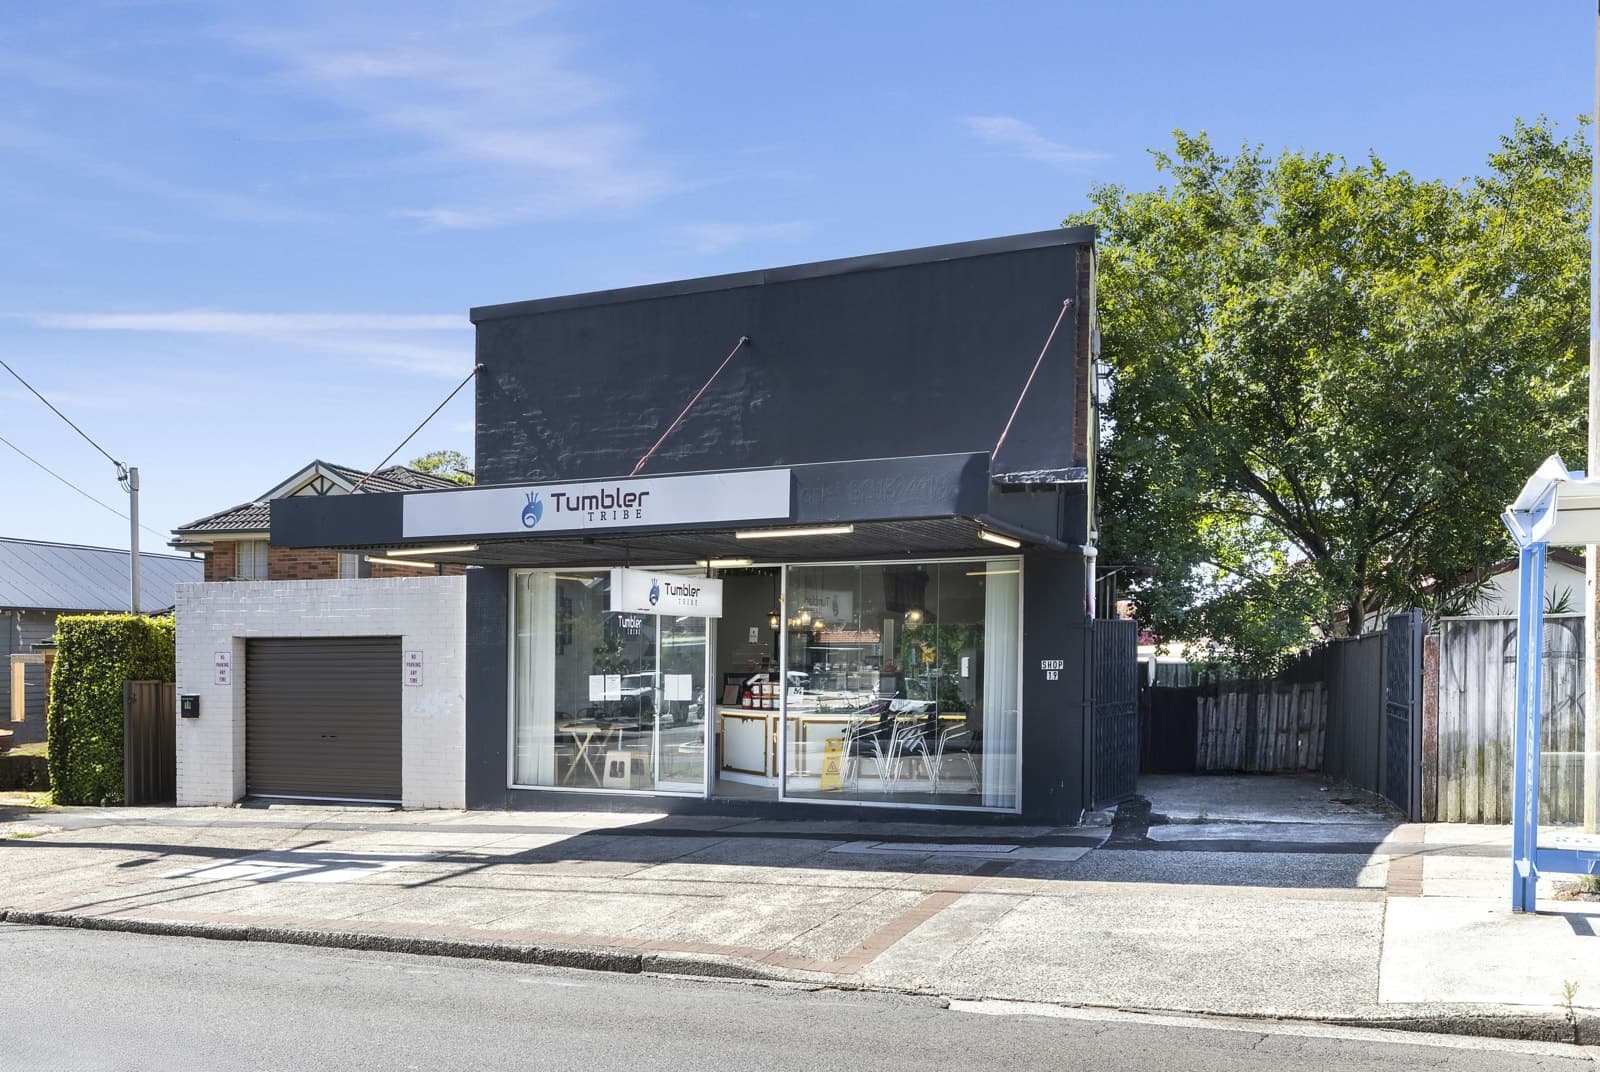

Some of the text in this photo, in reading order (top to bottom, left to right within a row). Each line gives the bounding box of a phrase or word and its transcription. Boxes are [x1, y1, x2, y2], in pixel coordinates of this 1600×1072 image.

[550, 487, 650, 513] Tumbler
[587, 509, 643, 522] TRIBE
[664, 582, 701, 597] Tumbler
[618, 615, 642, 628] Tumbler
[1041, 660, 1063, 669] SHOP
[1047, 671, 1058, 680] 19
